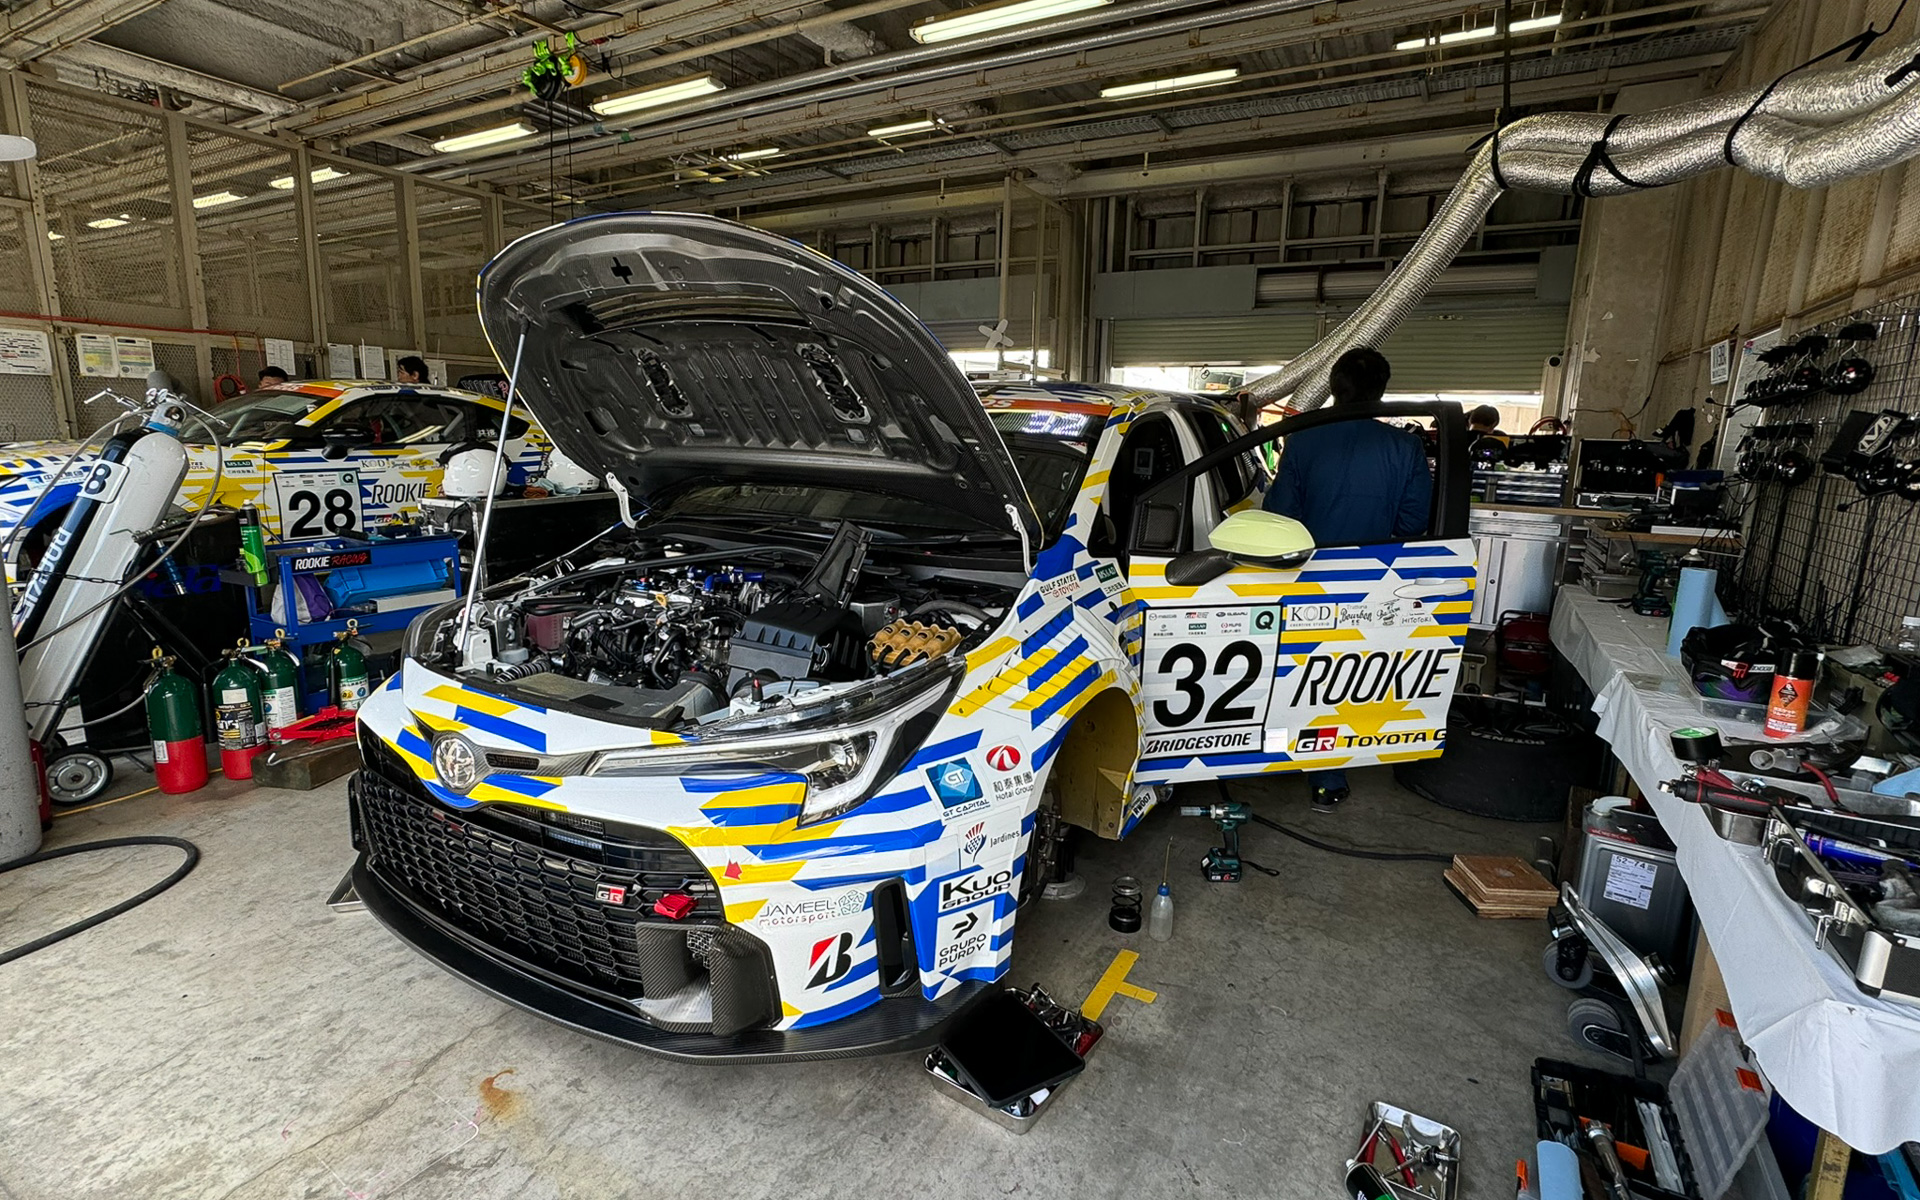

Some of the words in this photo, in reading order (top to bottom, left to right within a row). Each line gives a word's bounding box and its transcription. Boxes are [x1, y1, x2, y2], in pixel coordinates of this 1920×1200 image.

[84, 463, 112, 495] 8
[342, 473, 354, 484] Q
[371, 482, 433, 504] ROOKIE
[288, 488, 356, 538] 28
[295, 555, 330, 570] ROOKIE
[331, 552, 368, 565] RACING
[1039, 580, 1057, 594] GULF
[1057, 573, 1077, 587] STATES
[1059, 581, 1080, 596] TOYOTA
[1255, 610, 1274, 630] Q
[1291, 605, 1331, 621] KOD
[1153, 640, 1263, 727] 32
[1289, 647, 1462, 708] ROOKIE
[1145, 732, 1252, 754] BRIDGESTONE
[1296, 731, 1338, 752] GR
[1343, 732, 1427, 748] TOYOTA
[995, 790, 1014, 801] Hotai
[1014, 784, 1034, 796] Group
[943, 808, 954, 817] GT
[955, 799, 990, 813] CAPITAL
[990, 830, 1020, 847] Jardines
[597, 887, 623, 904] GR
[942, 882, 1011, 909] GROUP
[760, 900, 835, 917] JAMEEL
[938, 942, 985, 968] PURDY
[939, 933, 987, 957] GRUPO
